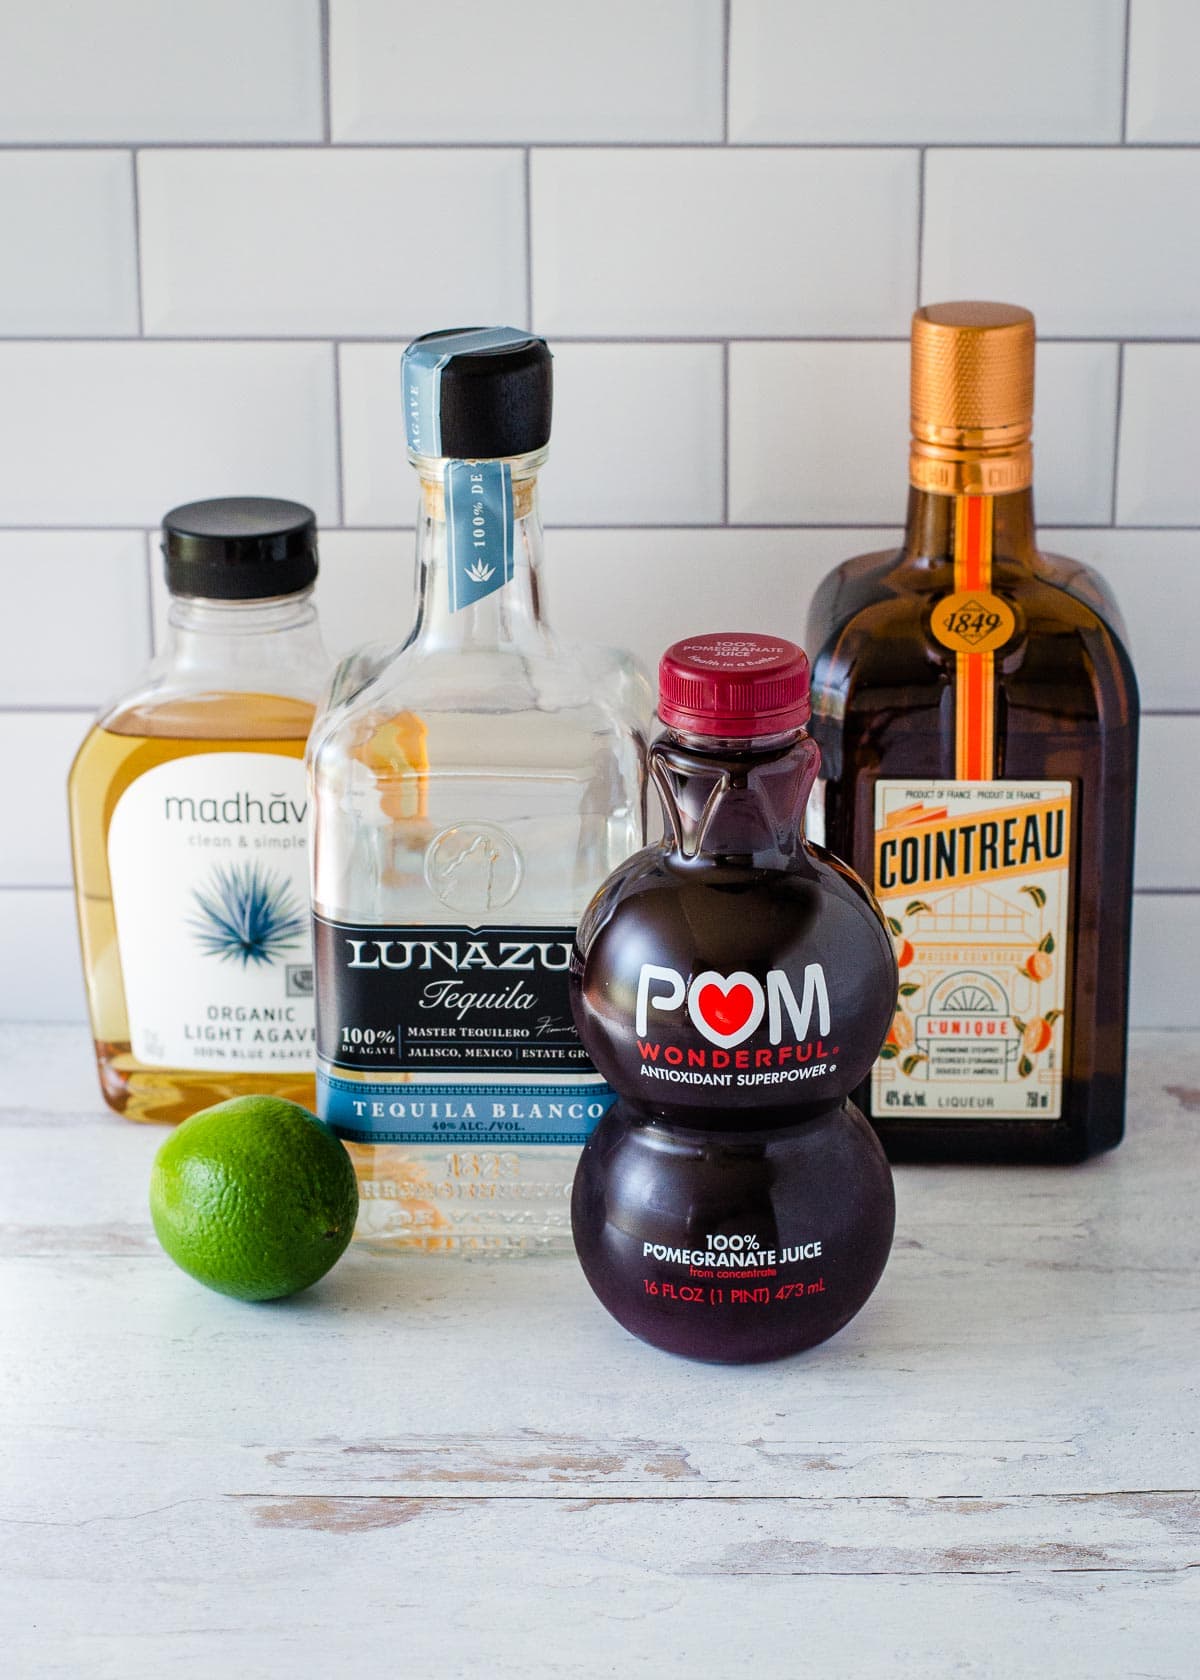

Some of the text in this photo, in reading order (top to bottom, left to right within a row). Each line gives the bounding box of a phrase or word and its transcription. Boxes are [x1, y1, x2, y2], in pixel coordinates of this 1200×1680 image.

[411, 384, 421, 449] AGAVE
[471, 473, 486, 548] 100% DE
[946, 612, 1001, 633] 1849
[683, 645, 784, 653] POMEGRANATE
[905, 790, 934, 799] PRODUCT
[937, 791, 945, 799] OF
[947, 791, 971, 799] FRANCE
[977, 791, 1004, 799] PRODUIT
[1017, 791, 1041, 800] FRANCE
[188, 834, 307, 850] clean & simple
[879, 809, 1064, 889] COINTREAU
[345, 939, 573, 972] LUNAZU
[418, 979, 538, 1020] Tequila
[636, 963, 831, 1049] POM
[207, 1006, 295, 1022] ORGANIC
[185, 1025, 245, 1041] LIGHT
[342, 1027, 395, 1044] 100%
[408, 1027, 530, 1038] MASTER TEQUILERO
[927, 1021, 1009, 1036] L'UNIQUE
[231, 1048, 263, 1058] BLUE
[270, 1049, 311, 1059] AGAVE
[342, 1044, 396, 1055] DE AGAVE
[408, 1048, 462, 1059] JALISCO,
[465, 1048, 513, 1058] MEXICO
[522, 1049, 566, 1059] ESTATE
[640, 1063, 827, 1086] ANTIOXIDANT SUPERPOWER
[353, 1101, 604, 1119] TEQUILA BLANCO
[938, 1096, 995, 1108] LIQUEUR
[432, 1121, 525, 1131] 40% ALC./VOL.
[706, 1234, 760, 1250] 100%
[643, 1241, 822, 1267] POMEGRANATE JUICE
[689, 1265, 777, 1279] from concentrate
[643, 1279, 658, 1295] 16
[710, 1289, 724, 1305] (1
[730, 1287, 770, 1305] PINT)
[775, 1283, 804, 1301] 473
[807, 1278, 826, 1295] mL
